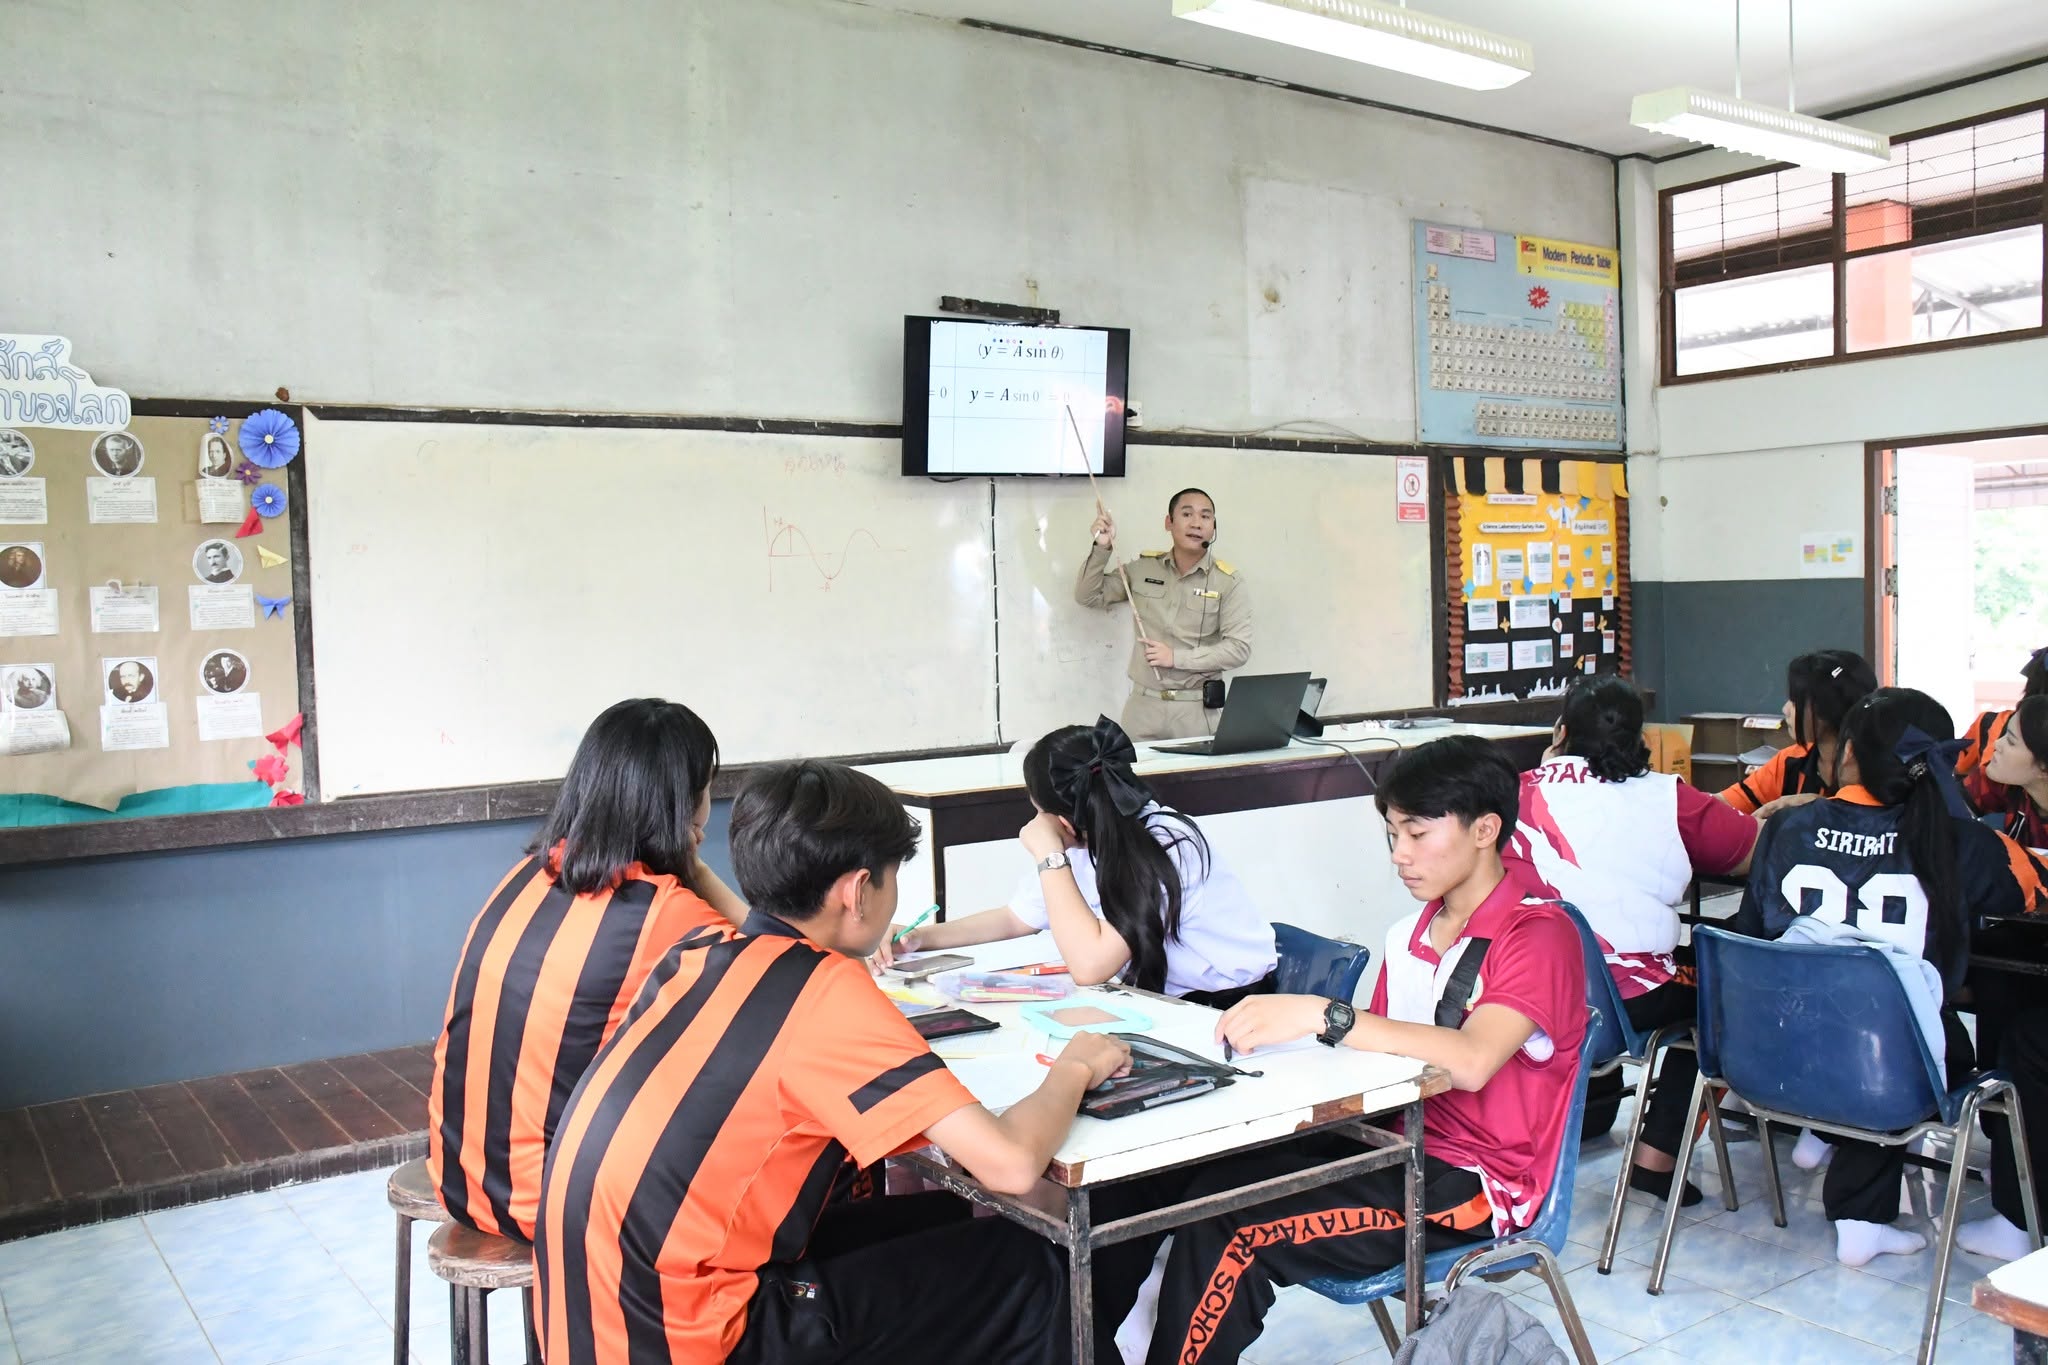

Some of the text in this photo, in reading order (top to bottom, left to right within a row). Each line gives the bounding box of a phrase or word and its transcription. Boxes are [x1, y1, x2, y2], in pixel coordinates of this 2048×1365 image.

[1543, 246, 1567, 262] Modern
[1571, 250, 1594, 266] Periodic
[1596, 254, 1611, 269] Table
[1026, 346, 1047, 359] sin
[1000, 388, 1009, 401] A
[1013, 389, 1029, 402] sin
